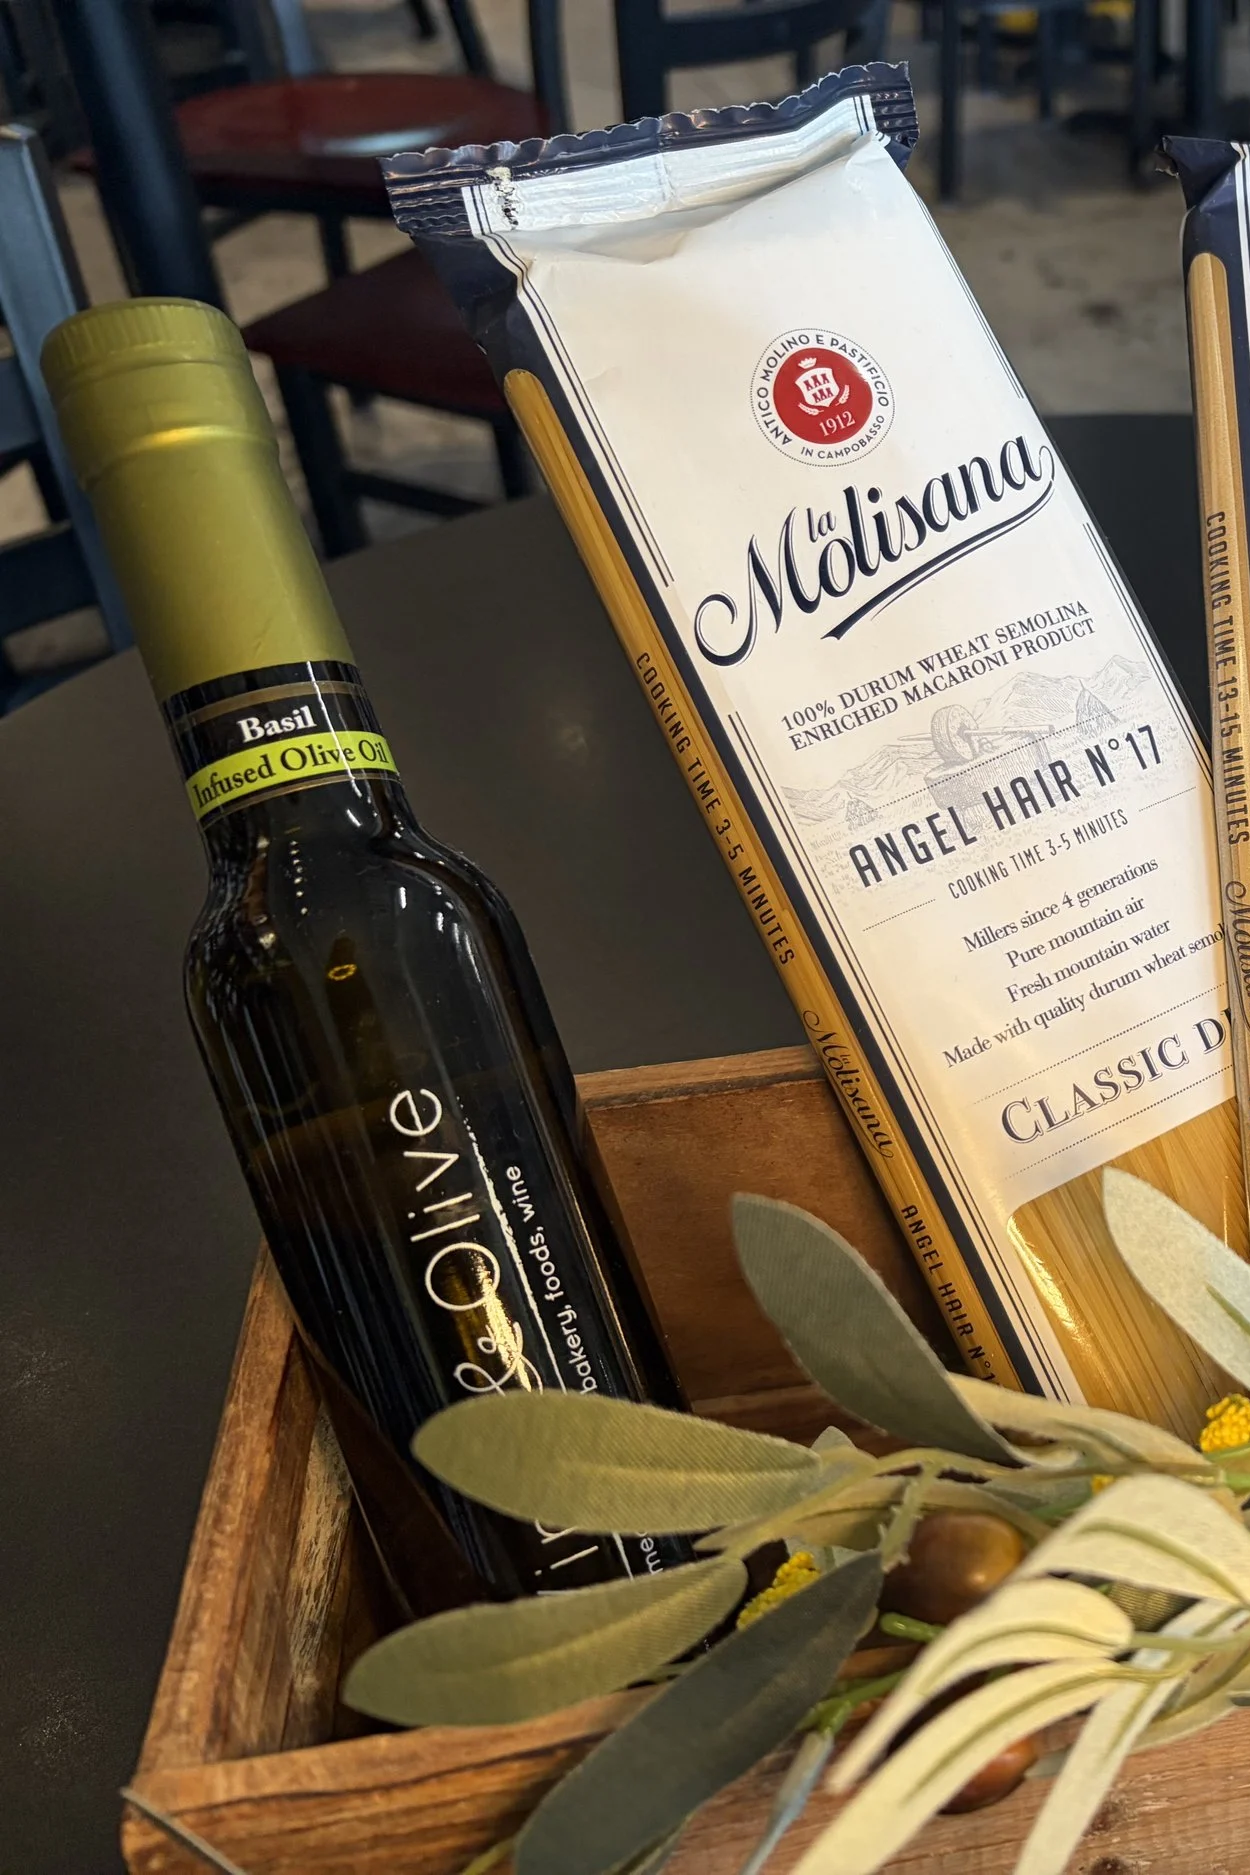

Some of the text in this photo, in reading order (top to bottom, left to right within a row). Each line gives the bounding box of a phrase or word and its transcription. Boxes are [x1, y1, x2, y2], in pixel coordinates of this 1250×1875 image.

[757, 334, 889, 445] ANTICO MOLINO E PASTIFICIO
[800, 415, 885, 459] IN CAMPOBASSO
[819, 411, 856, 436] 1912
[694, 436, 1055, 667] la Molisana
[781, 600, 1090, 731] 100% DURUM WHEAT SEMOLINA
[788, 618, 1096, 751] ENRICHED MACARONI PRODUCT
[1207, 511, 1250, 846] COOKING TIME 13-15 MINUTES
[193, 739, 389, 808] Infused Olive Oil
[237, 705, 317, 743] Basil
[636, 652, 795, 965] COOKING TIME 3-5 MINUTES
[848, 805, 978, 888] ANGEL
[983, 759, 1080, 831] HAIR
[948, 808, 1129, 899] COOKING TIME 3-5 MINUTES
[962, 857, 1159, 952] Millers since 4 generations
[1005, 896, 1145, 968] Pure mountain air
[942, 1039, 993, 1068] Made
[993, 1017, 1032, 1045] with
[1034, 992, 1086, 1029] quality
[1088, 967, 1143, 1001] durum
[1142, 945, 1188, 975] wheat
[1005, 918, 1171, 1003] Fresh mountain water
[802, 1010, 894, 1159] la Molisana
[1001, 1033, 1189, 1144] CLASSIC
[390, 1088, 501, 1312] Olive
[507, 1166, 534, 1222] wine
[529, 1224, 566, 1301] foods,
[901, 1204, 944, 1274] ANGEL
[938, 1282, 973, 1337] HAIR
